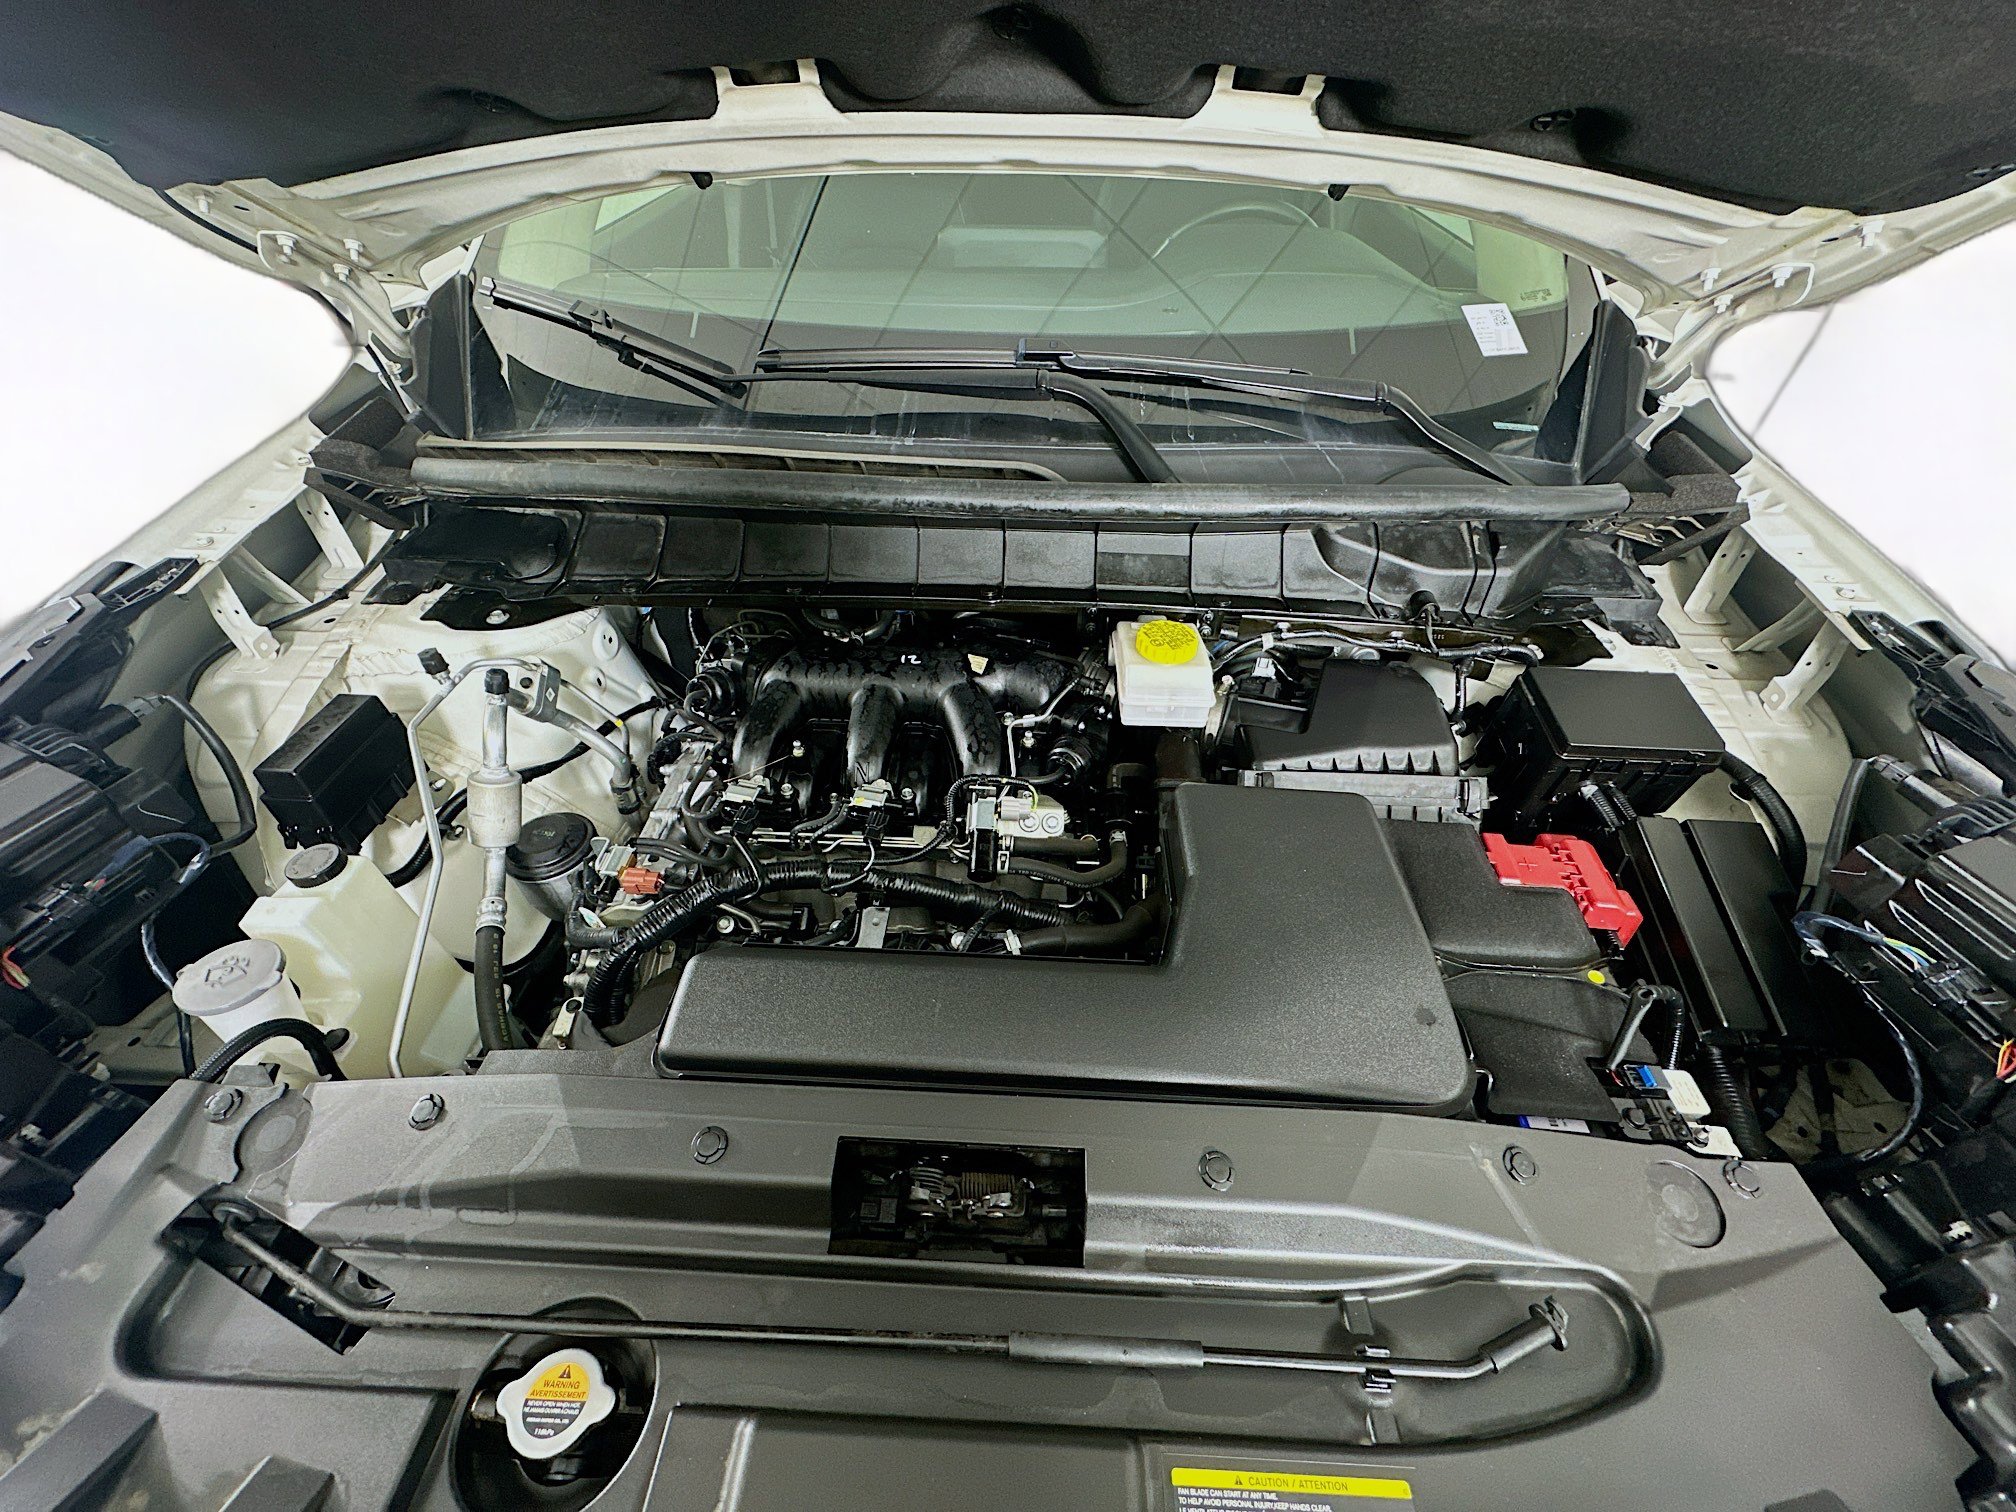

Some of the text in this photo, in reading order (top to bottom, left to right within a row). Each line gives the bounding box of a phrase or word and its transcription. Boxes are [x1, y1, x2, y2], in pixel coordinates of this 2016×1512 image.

[543, 1380, 580, 1389] WARNING
[530, 1389, 587, 1398] AVERTISSEMENT
[1248, 1476, 1289, 1488] CAUTION
[1299, 1479, 1349, 1491] ATTENTION
[1177, 1487, 1190, 1495] FAN
[1190, 1488, 1209, 1497] BLADE
[1209, 1489, 1223, 1498] CAN
[1223, 1490, 1242, 1498] START
[1242, 1491, 1250, 1499] AT
[1250, 1491, 1262, 1499] ANY
[1178, 1497, 1187, 1505] TO
[1187, 1498, 1203, 1506] HELP
[1204, 1498, 1222, 1507] AVOID
[1222, 1499, 1254, 1509] PERSONAL
[1289, 1503, 1311, 1511] HANDS
